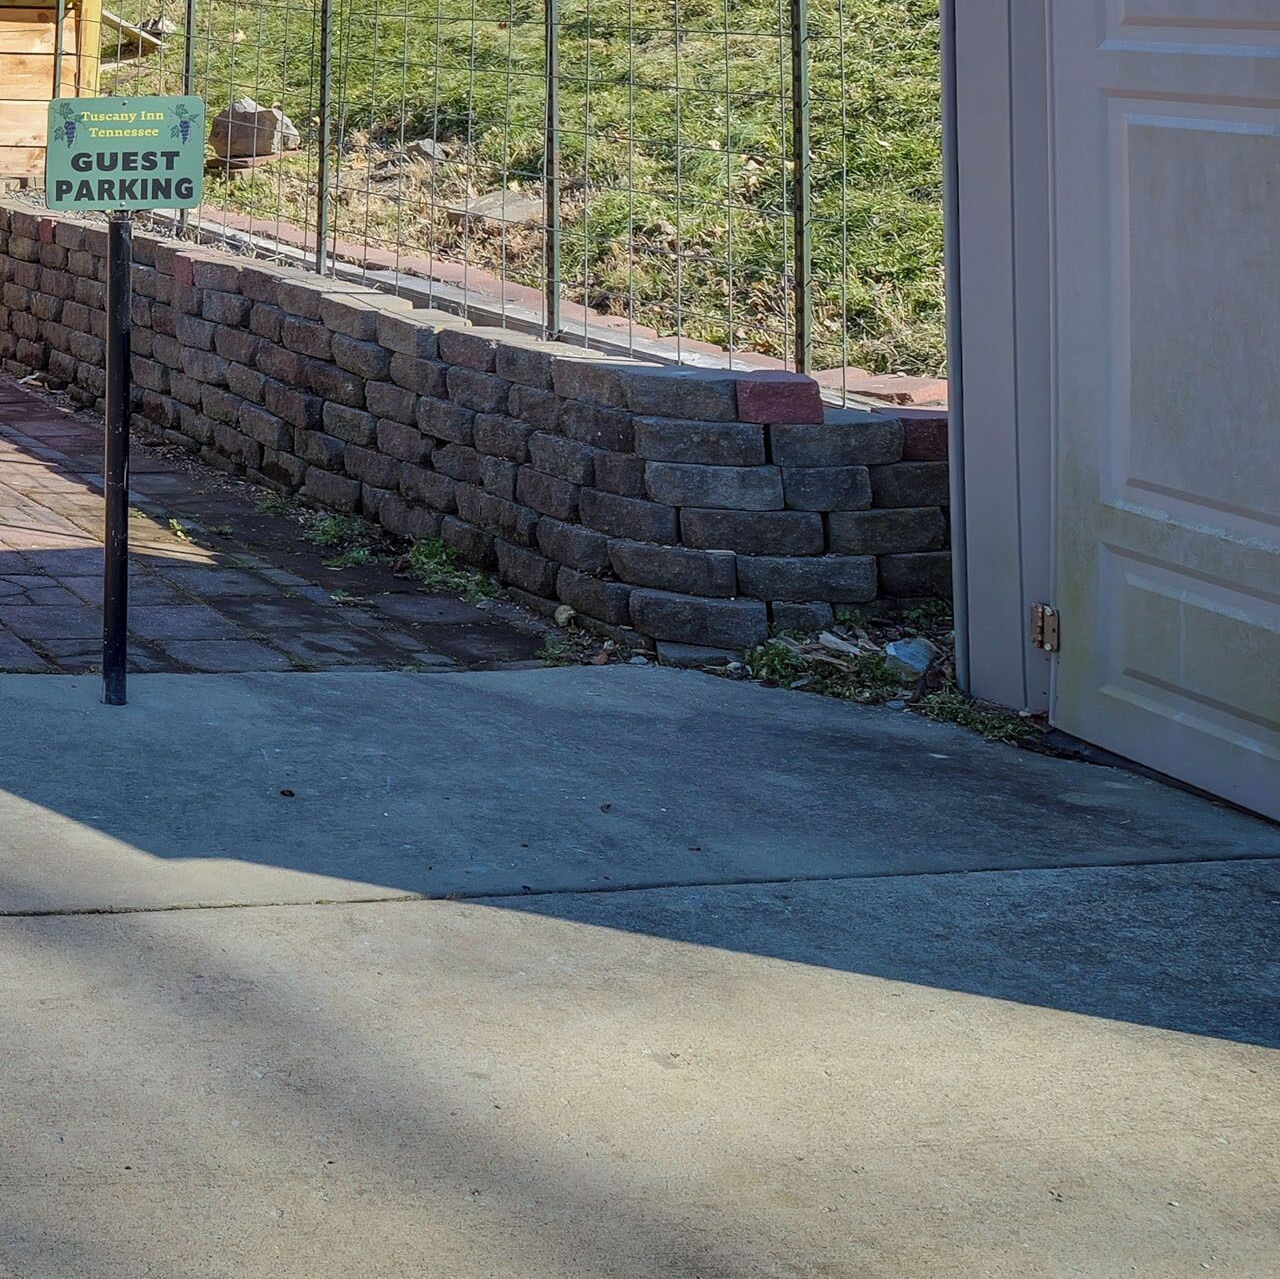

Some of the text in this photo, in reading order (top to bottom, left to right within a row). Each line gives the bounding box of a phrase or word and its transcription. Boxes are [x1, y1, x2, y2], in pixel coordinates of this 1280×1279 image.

[80, 110, 165, 123] Tuscany Inn
[88, 126, 160, 138] Tennessee
[70, 150, 181, 172] GUEST
[55, 177, 194, 202] PARKING
